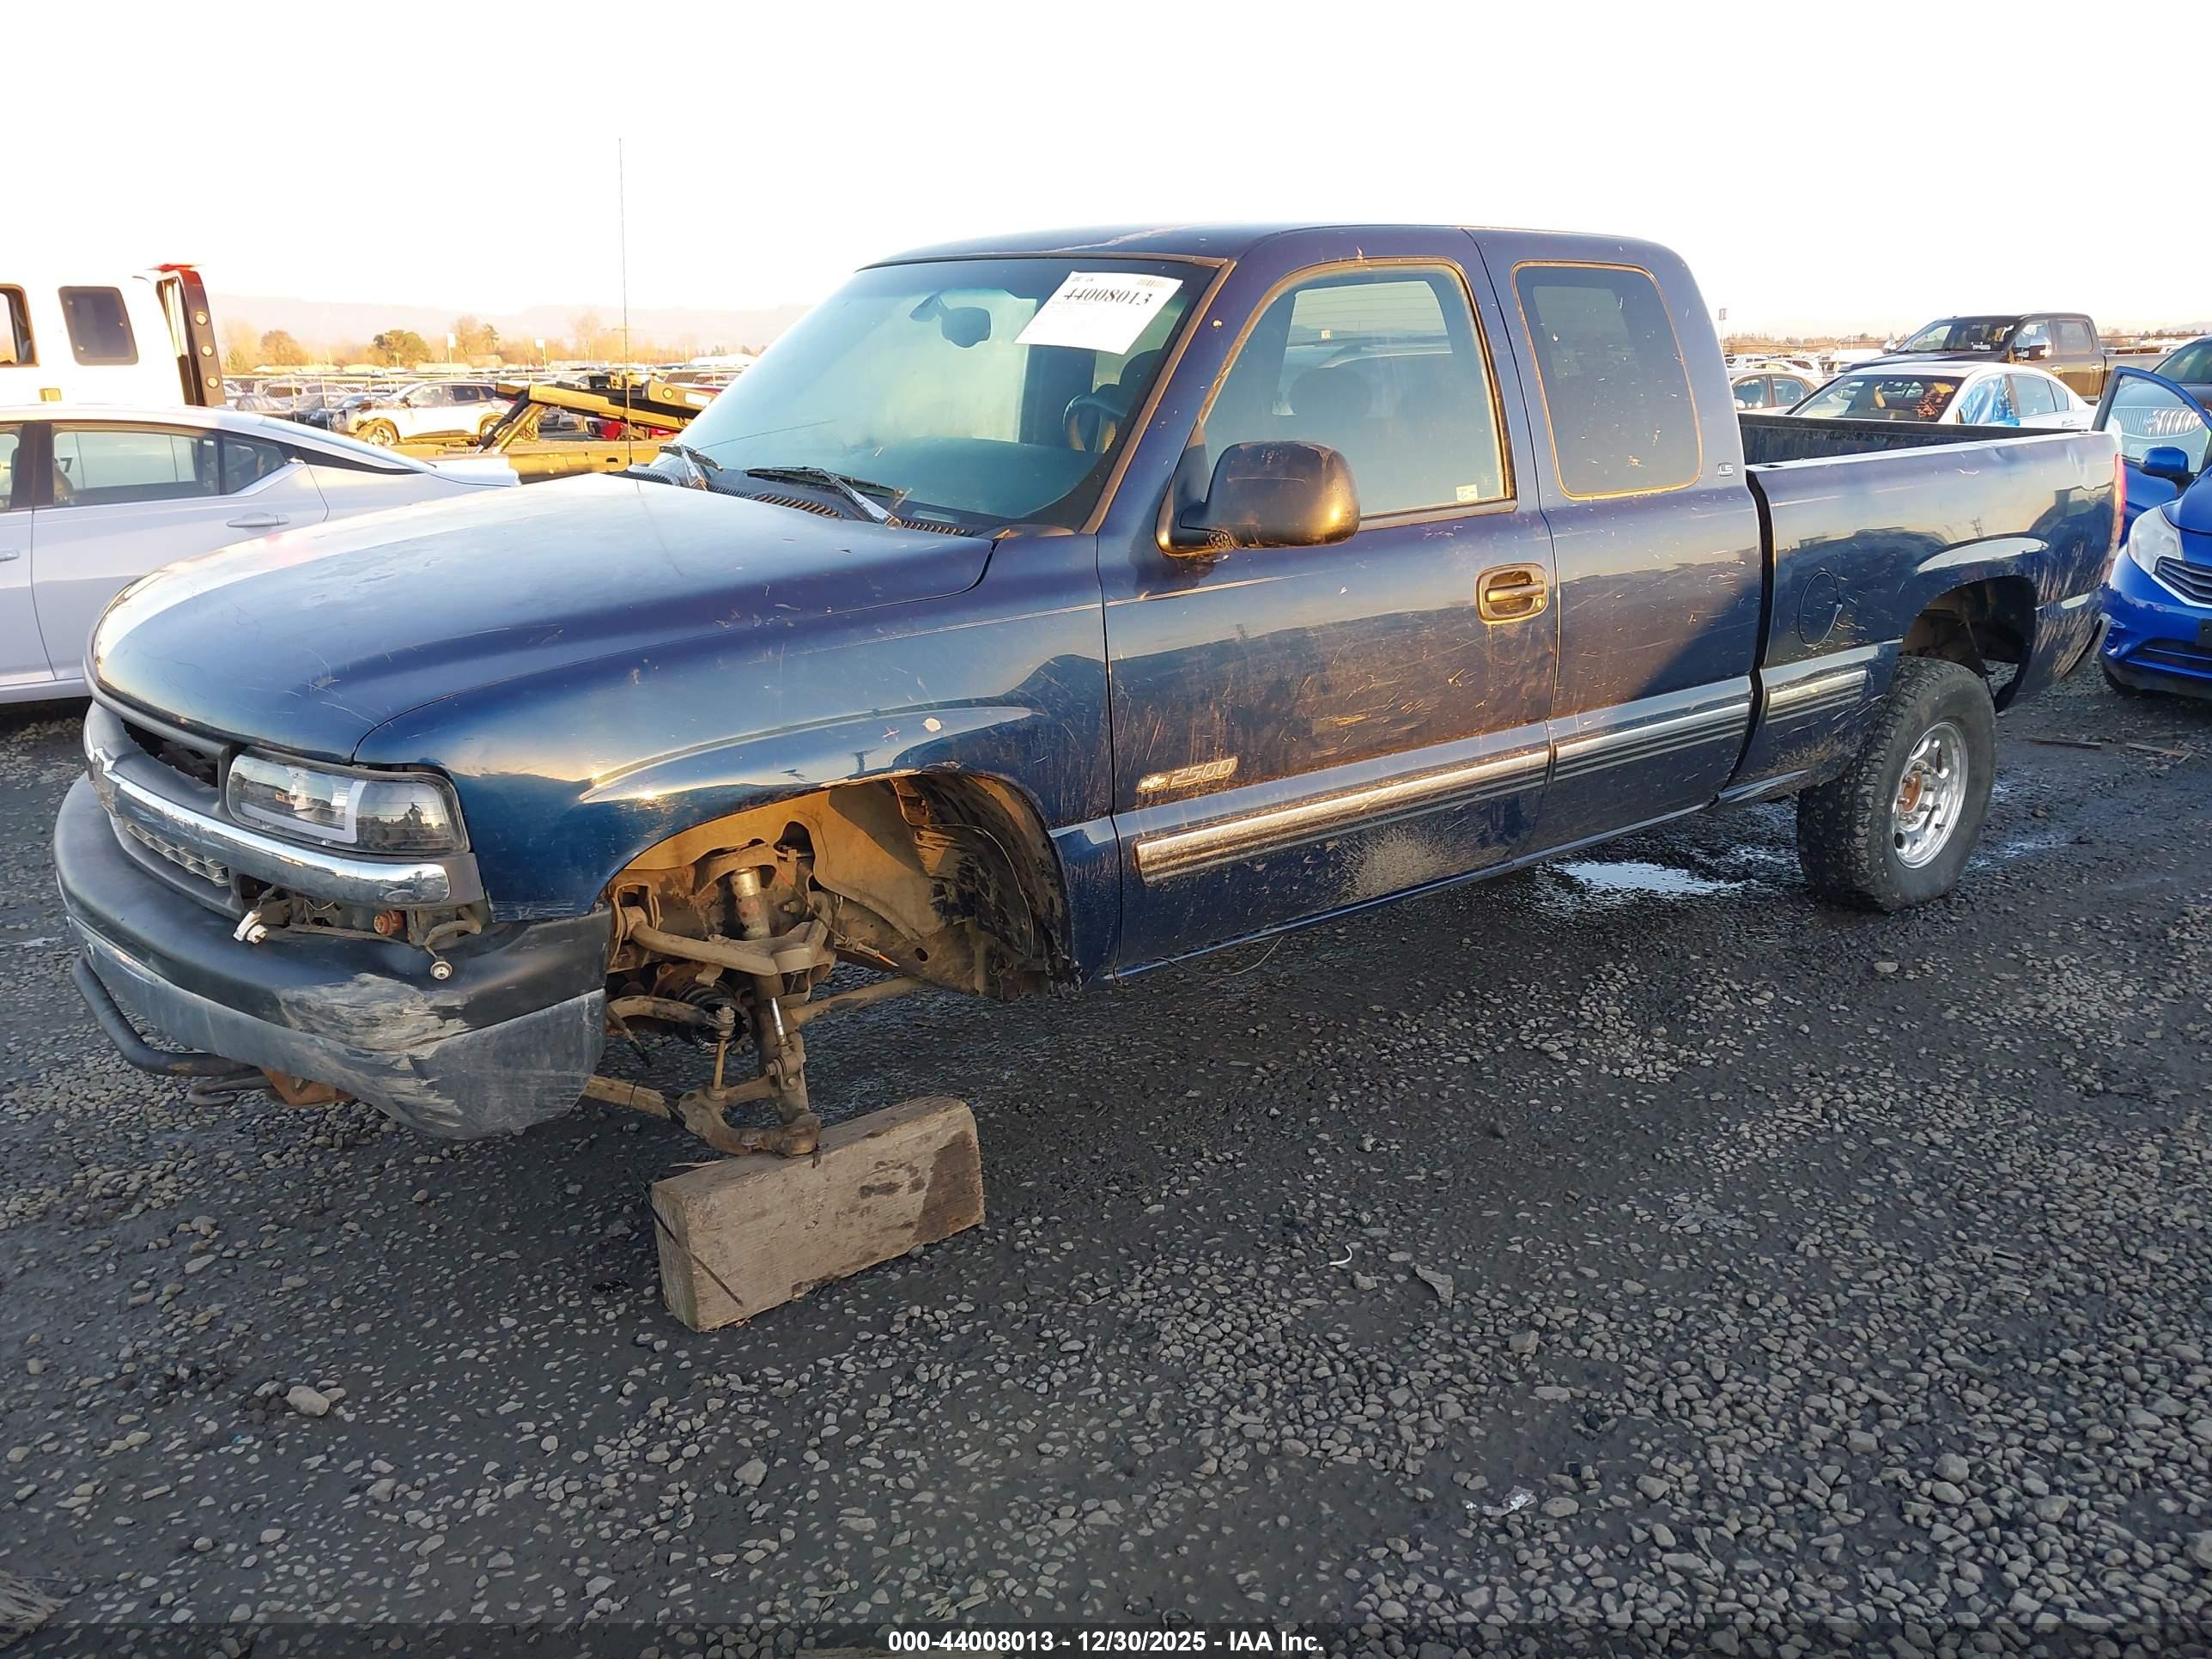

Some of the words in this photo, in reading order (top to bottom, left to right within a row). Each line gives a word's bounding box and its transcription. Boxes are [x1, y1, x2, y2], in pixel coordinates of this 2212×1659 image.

[1063, 288, 1153, 307] 44008013
[1717, 465, 1734, 475] LS
[1170, 758, 1236, 787] 2500
